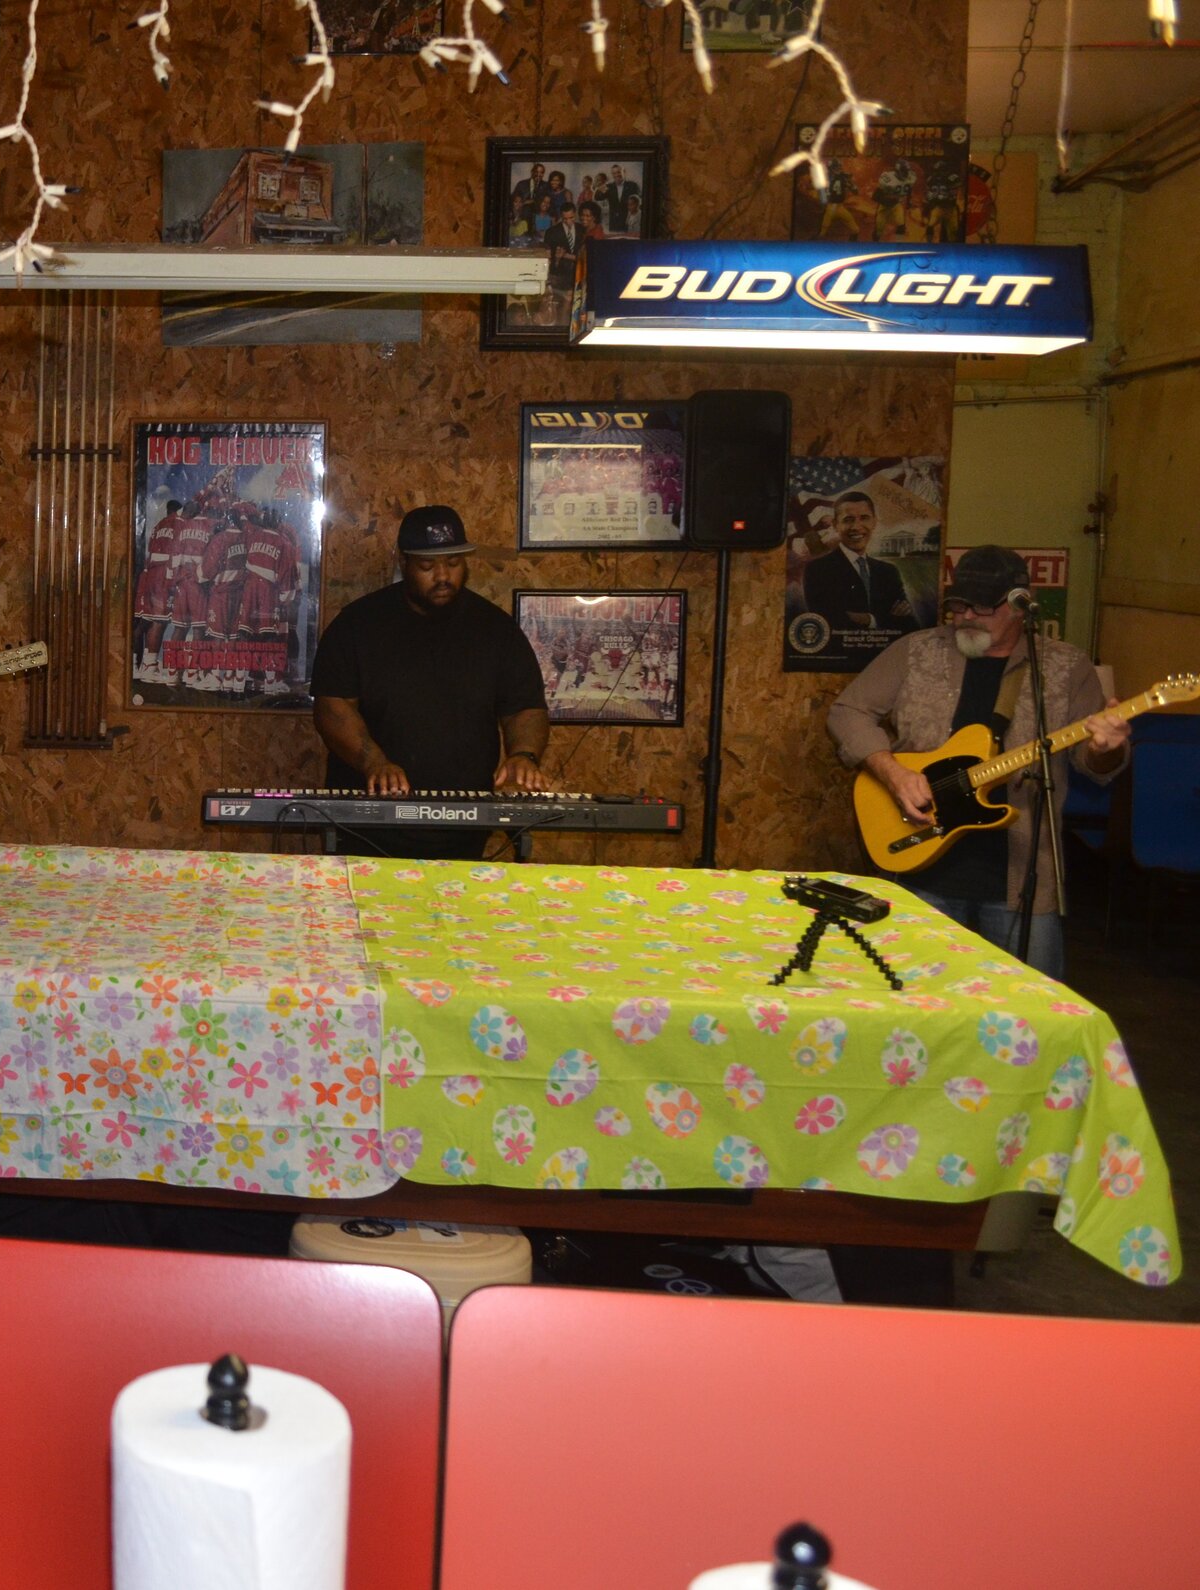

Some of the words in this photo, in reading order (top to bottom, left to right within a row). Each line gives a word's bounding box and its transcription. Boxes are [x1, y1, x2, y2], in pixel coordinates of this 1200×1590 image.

[619, 266, 791, 301] BUD
[827, 269, 1054, 306] LIGHT
[147, 435, 202, 465] HOG
[209, 435, 314, 465] HEAVEN
[249, 542, 281, 561] ARKANSAS
[220, 806, 252, 816] 07
[418, 806, 478, 821] Roland
